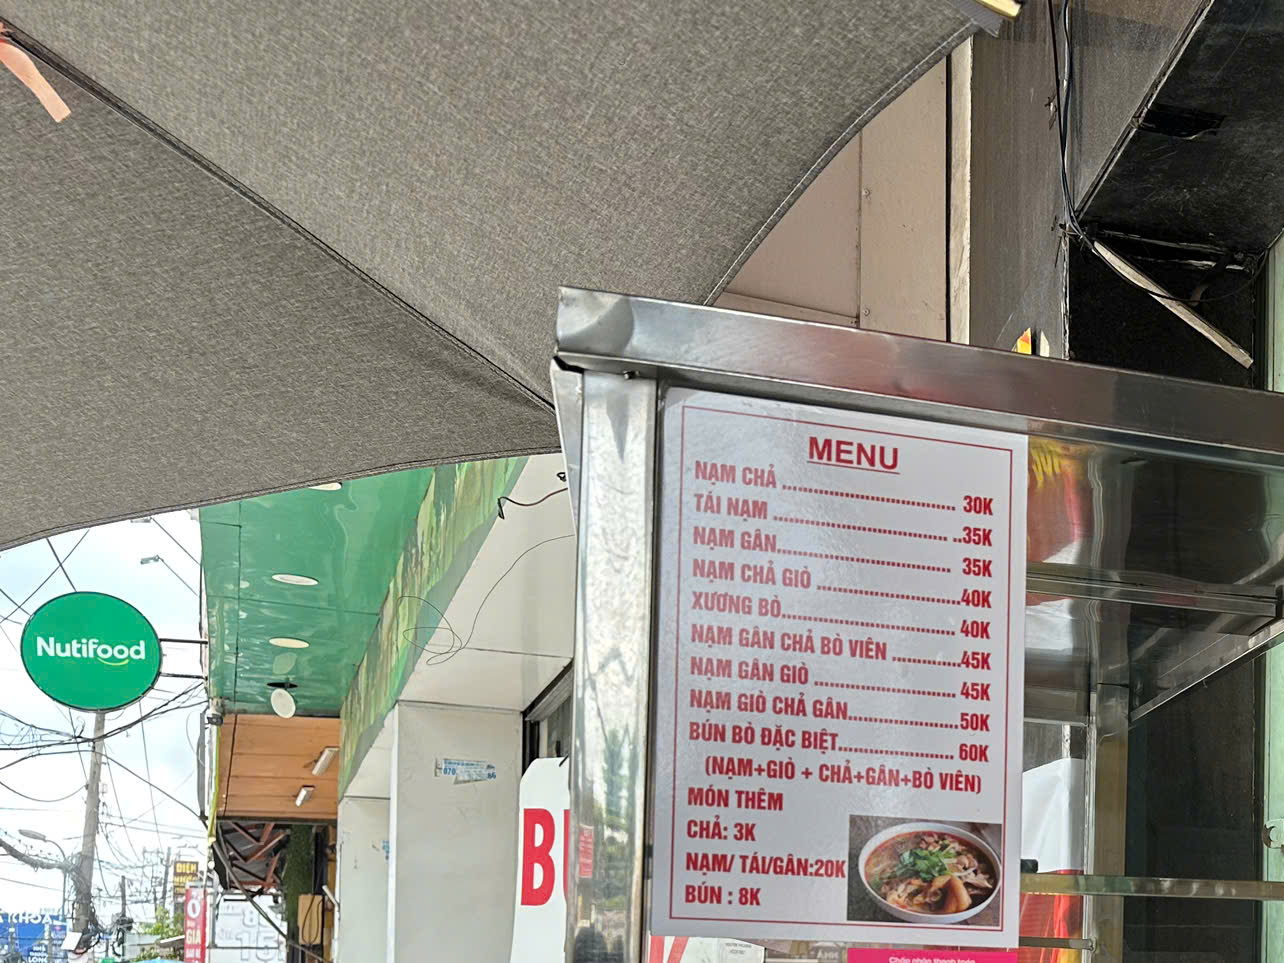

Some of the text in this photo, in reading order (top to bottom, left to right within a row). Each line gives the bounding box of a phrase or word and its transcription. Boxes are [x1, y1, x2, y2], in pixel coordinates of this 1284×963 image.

[808, 436, 899, 470] MENU
[695, 460, 993, 516] NẠM CHẢ 30K
[694, 493, 992, 547] TÁI NẠM 35K
[693, 526, 992, 578] NẠM GÂN 35K
[693, 558, 992, 609] NẠM CHẢ GIÒ 40K
[692, 591, 990, 640] XƯƠNG BÒ 40K
[36, 636, 146, 660] Nutifood
[691, 623, 991, 671] NẠM GÂN CHẢ BÒ VIÊN 45K
[690, 656, 990, 702] NẠM GÂN GIÒ 45K
[690, 689, 990, 732] NẠM GIÒ CHẢ GÂN 50K
[689, 718, 989, 763] BÚN BÒ ĐẶC BIỆT 60K
[705, 757, 796, 782] (NẠM+GIÒ
[801, 768, 812, 780] +
[939, 769, 982, 795] VIÊN)
[688, 786, 784, 812] MÓN THÊM
[687, 814, 756, 843] CHẢ: 3K
[686, 852, 736, 878] NẠM/
[685, 883, 722, 905] BÚN
[738, 887, 761, 906] 8K
